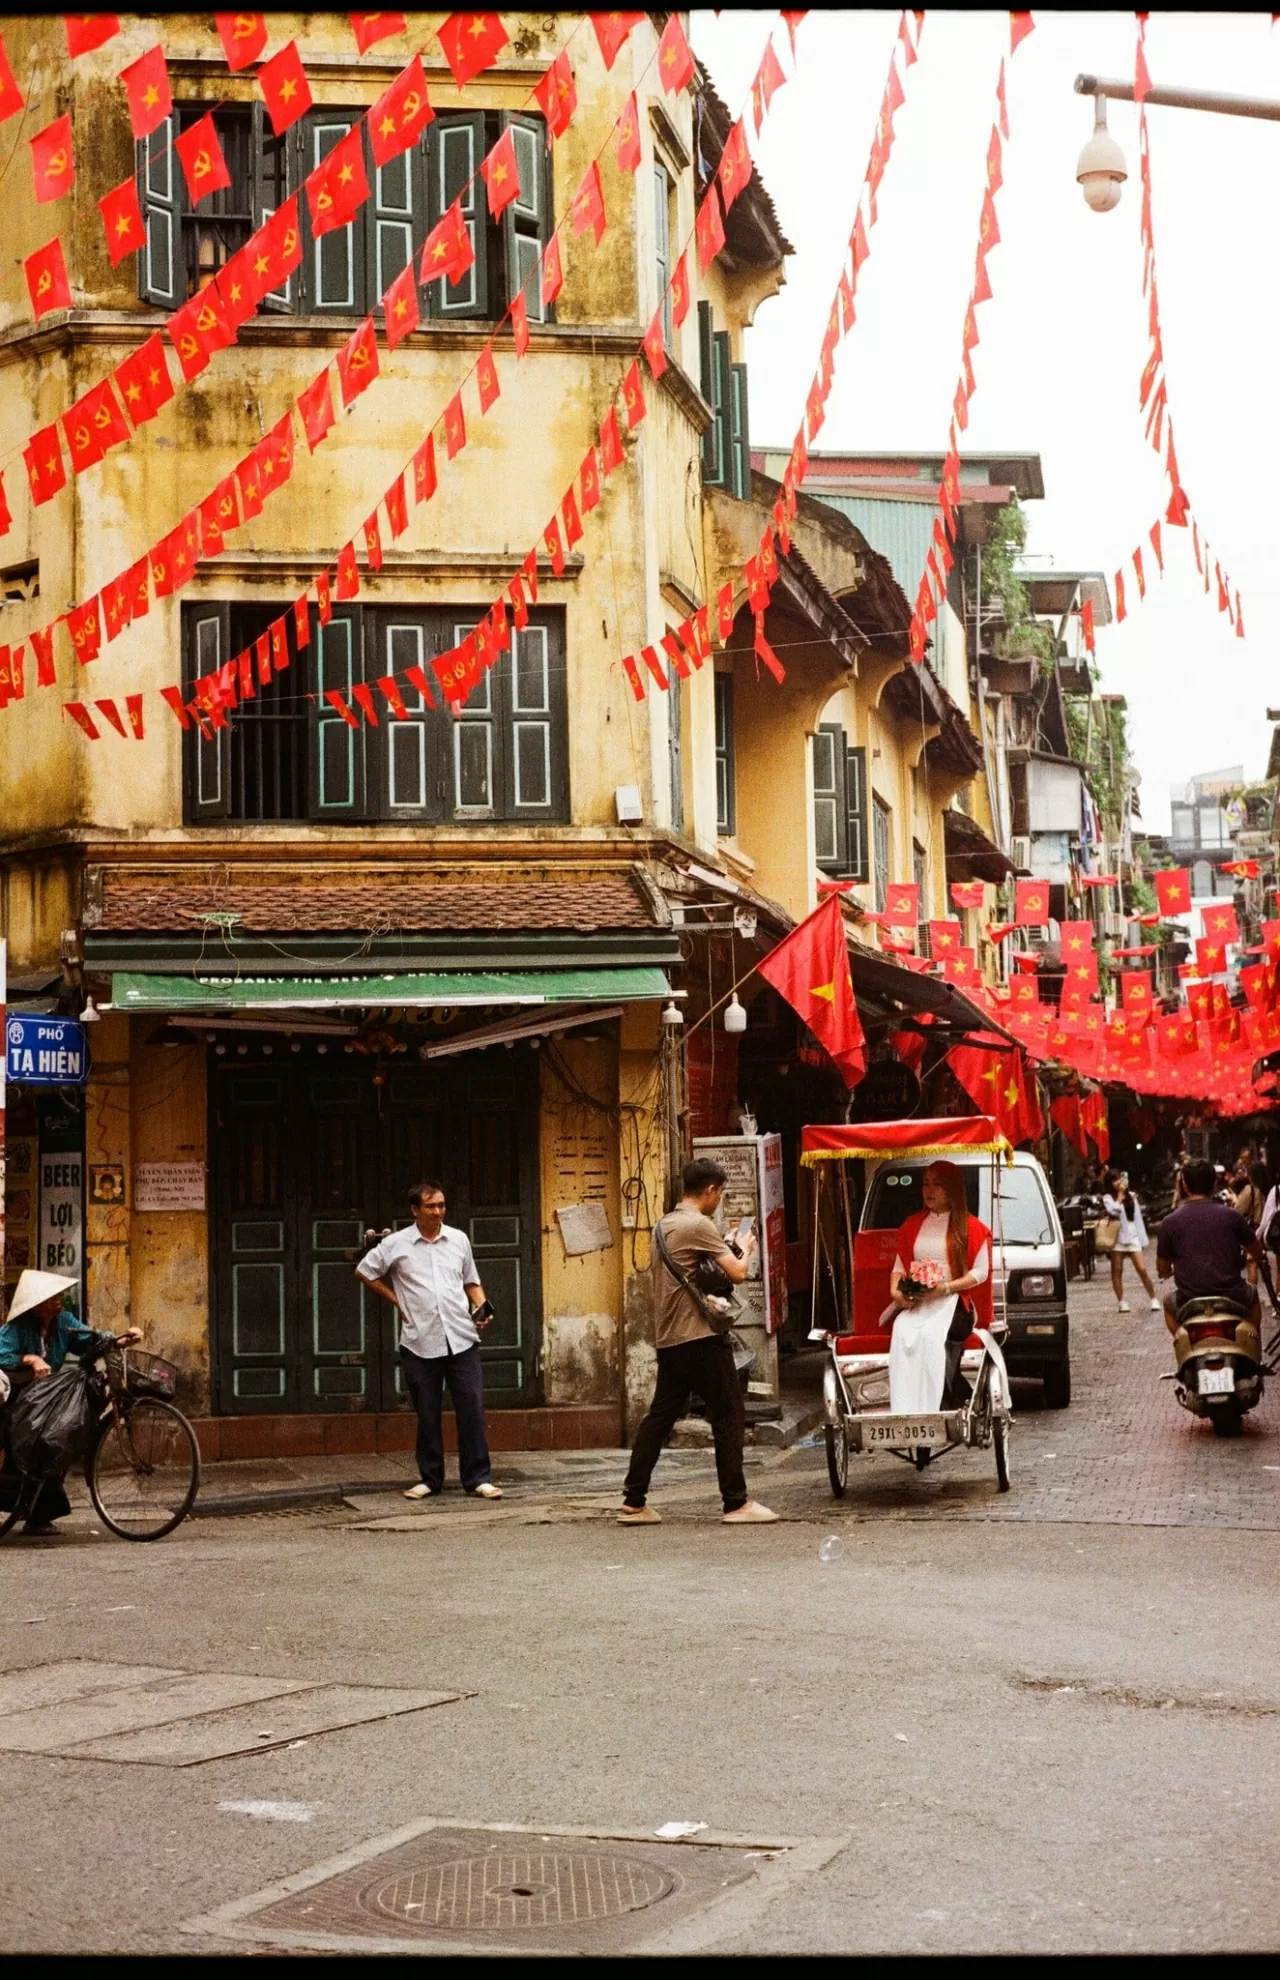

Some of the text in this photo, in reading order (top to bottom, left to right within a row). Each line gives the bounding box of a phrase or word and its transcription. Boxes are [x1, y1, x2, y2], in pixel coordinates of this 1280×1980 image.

[199, 976, 285, 984] PROBABLY
[292, 976, 323, 984] THE
[38, 1023, 65, 1041] PHỐ
[11, 1046, 80, 1078] TẠ HIỆN
[43, 1164, 80, 1187] BEER
[50, 1200, 73, 1233] LỢI
[46, 1238, 76, 1267] BÉO
